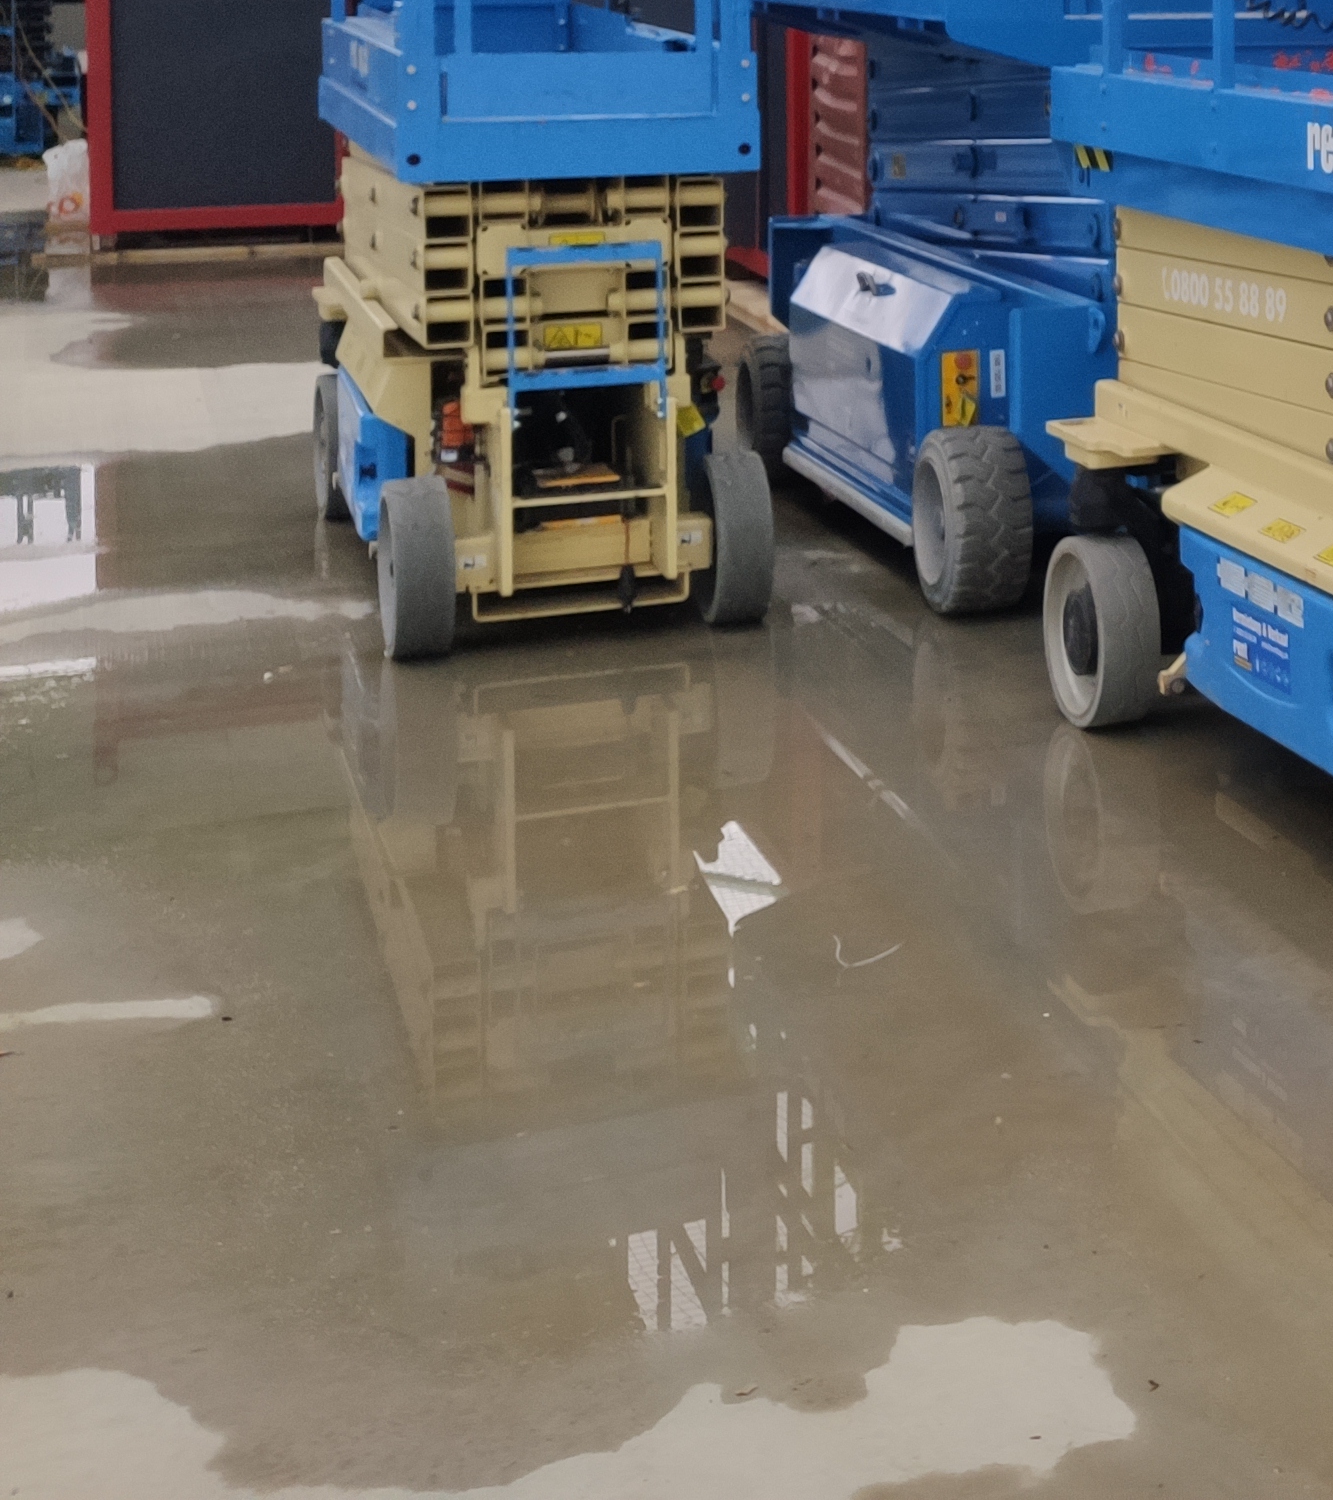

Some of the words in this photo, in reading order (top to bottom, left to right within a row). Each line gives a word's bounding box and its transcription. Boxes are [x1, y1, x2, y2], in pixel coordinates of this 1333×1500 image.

[1171, 268, 1209, 307] 0800
[1215, 277, 1234, 313] 55
[1239, 281, 1260, 318] 88
[1265, 286, 1287, 323] 89
